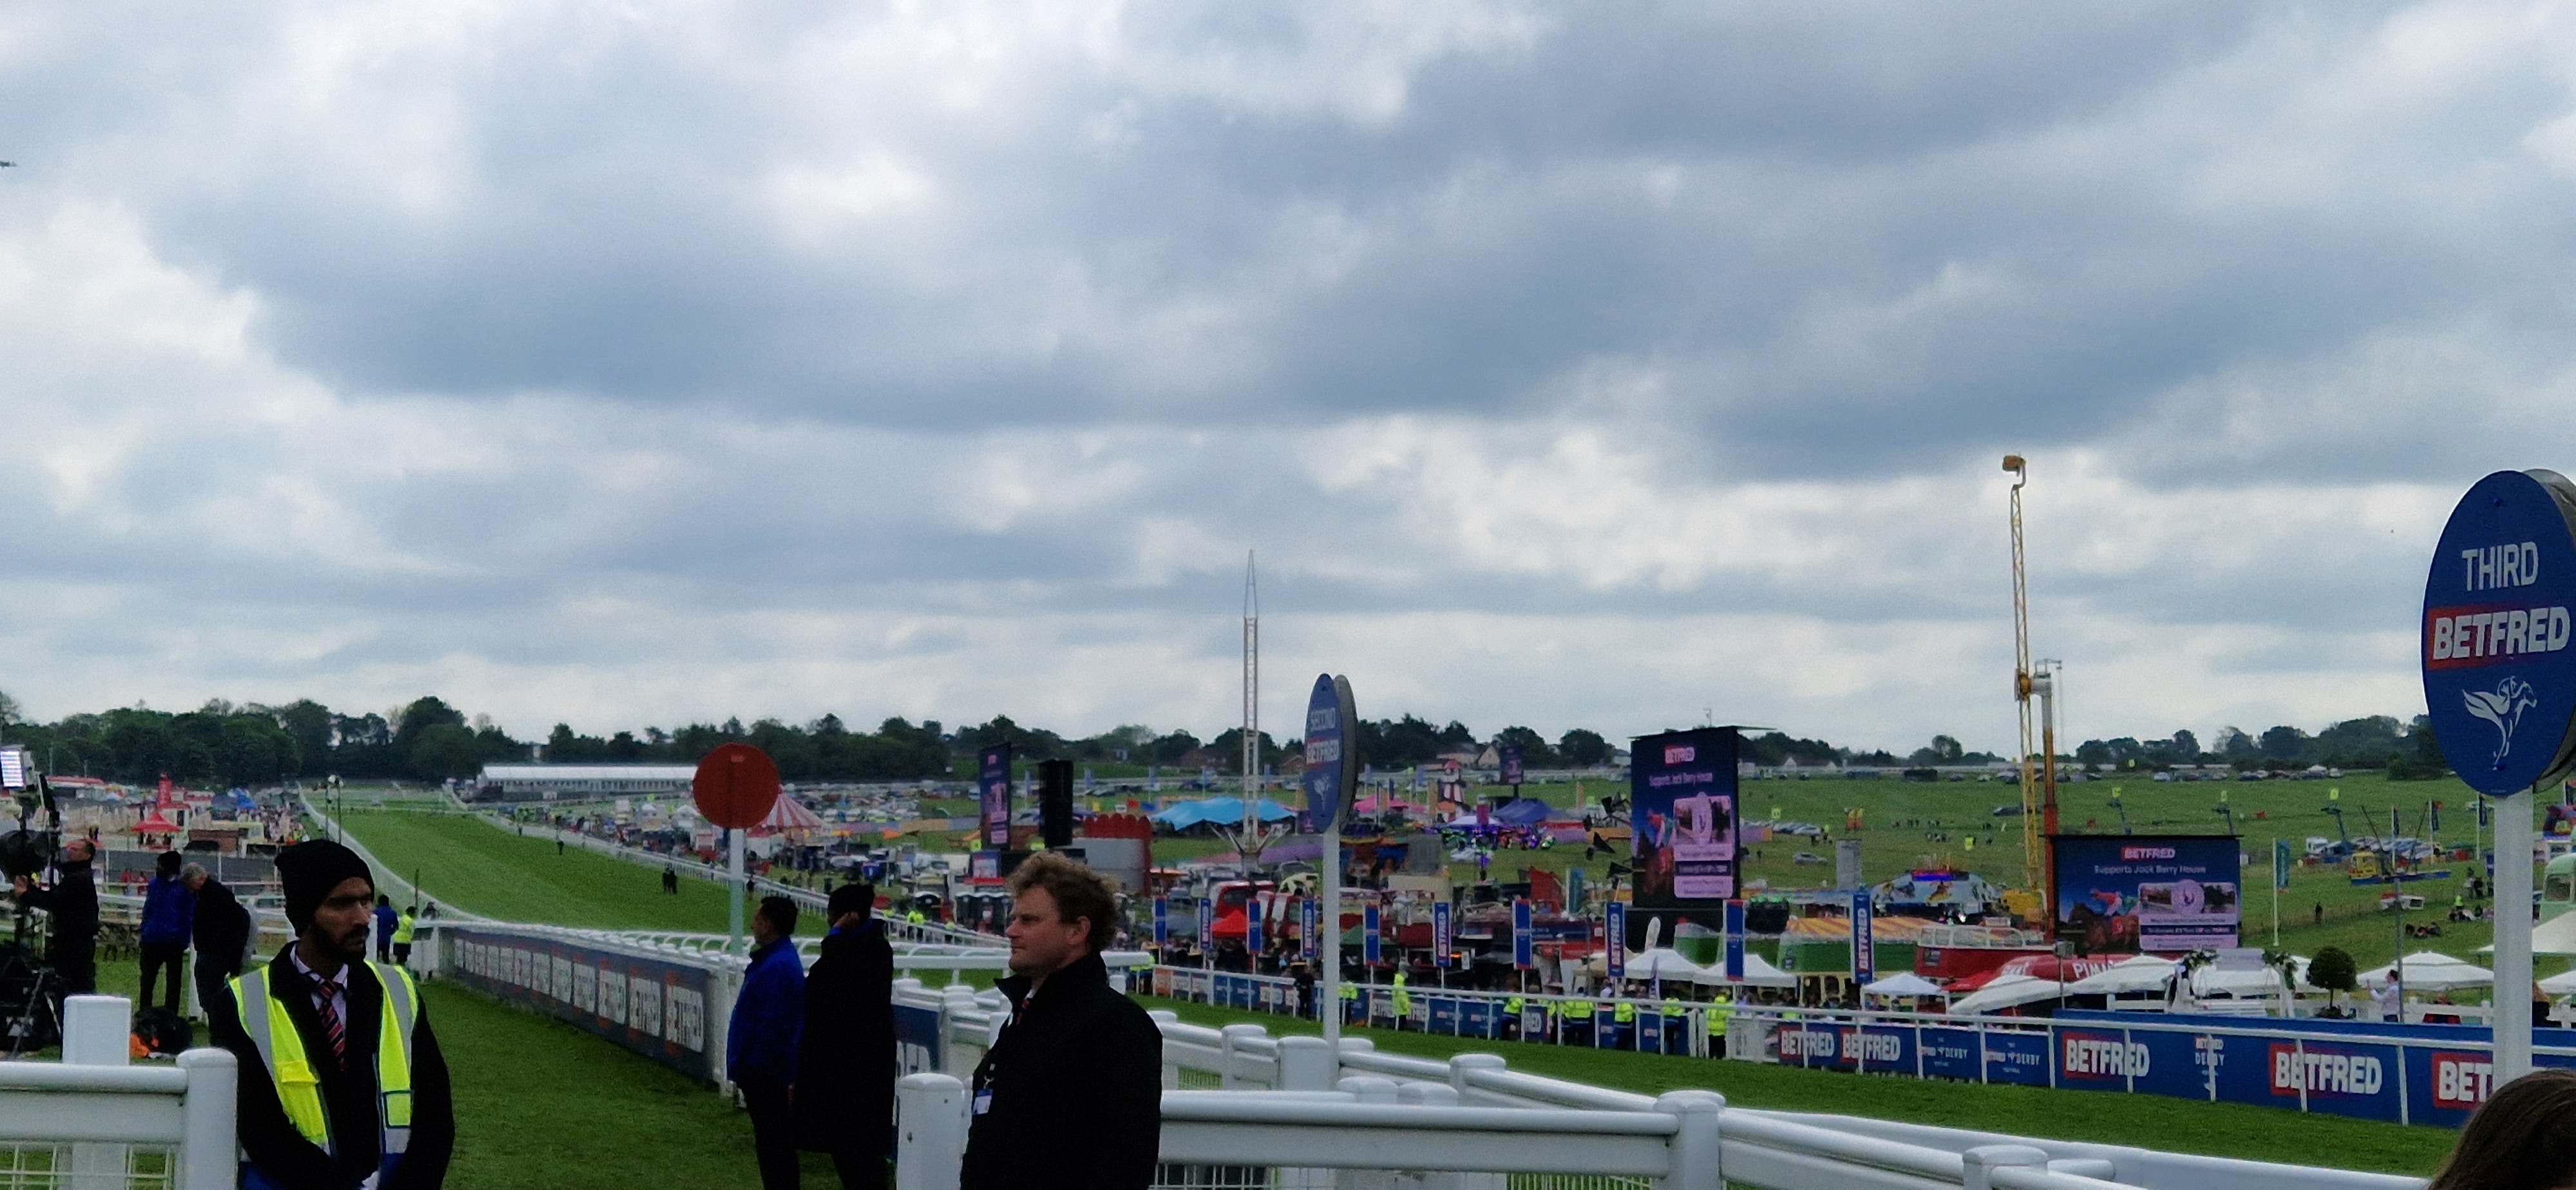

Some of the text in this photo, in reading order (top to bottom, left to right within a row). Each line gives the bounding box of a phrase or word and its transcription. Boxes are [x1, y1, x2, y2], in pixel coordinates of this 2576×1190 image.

[2461, 542, 2539, 591] THIRD
[2432, 607, 2570, 661] BETFRED
[2125, 847, 2175, 859] BETFRED
[1857, 907, 1868, 969] BETFRED
[1781, 1030, 1835, 1057] BETFRED
[1842, 1033, 1900, 1062] BETFRED
[2065, 1039, 2150, 1077] BETFRED
[2275, 1052, 2382, 1095] BETFRED
